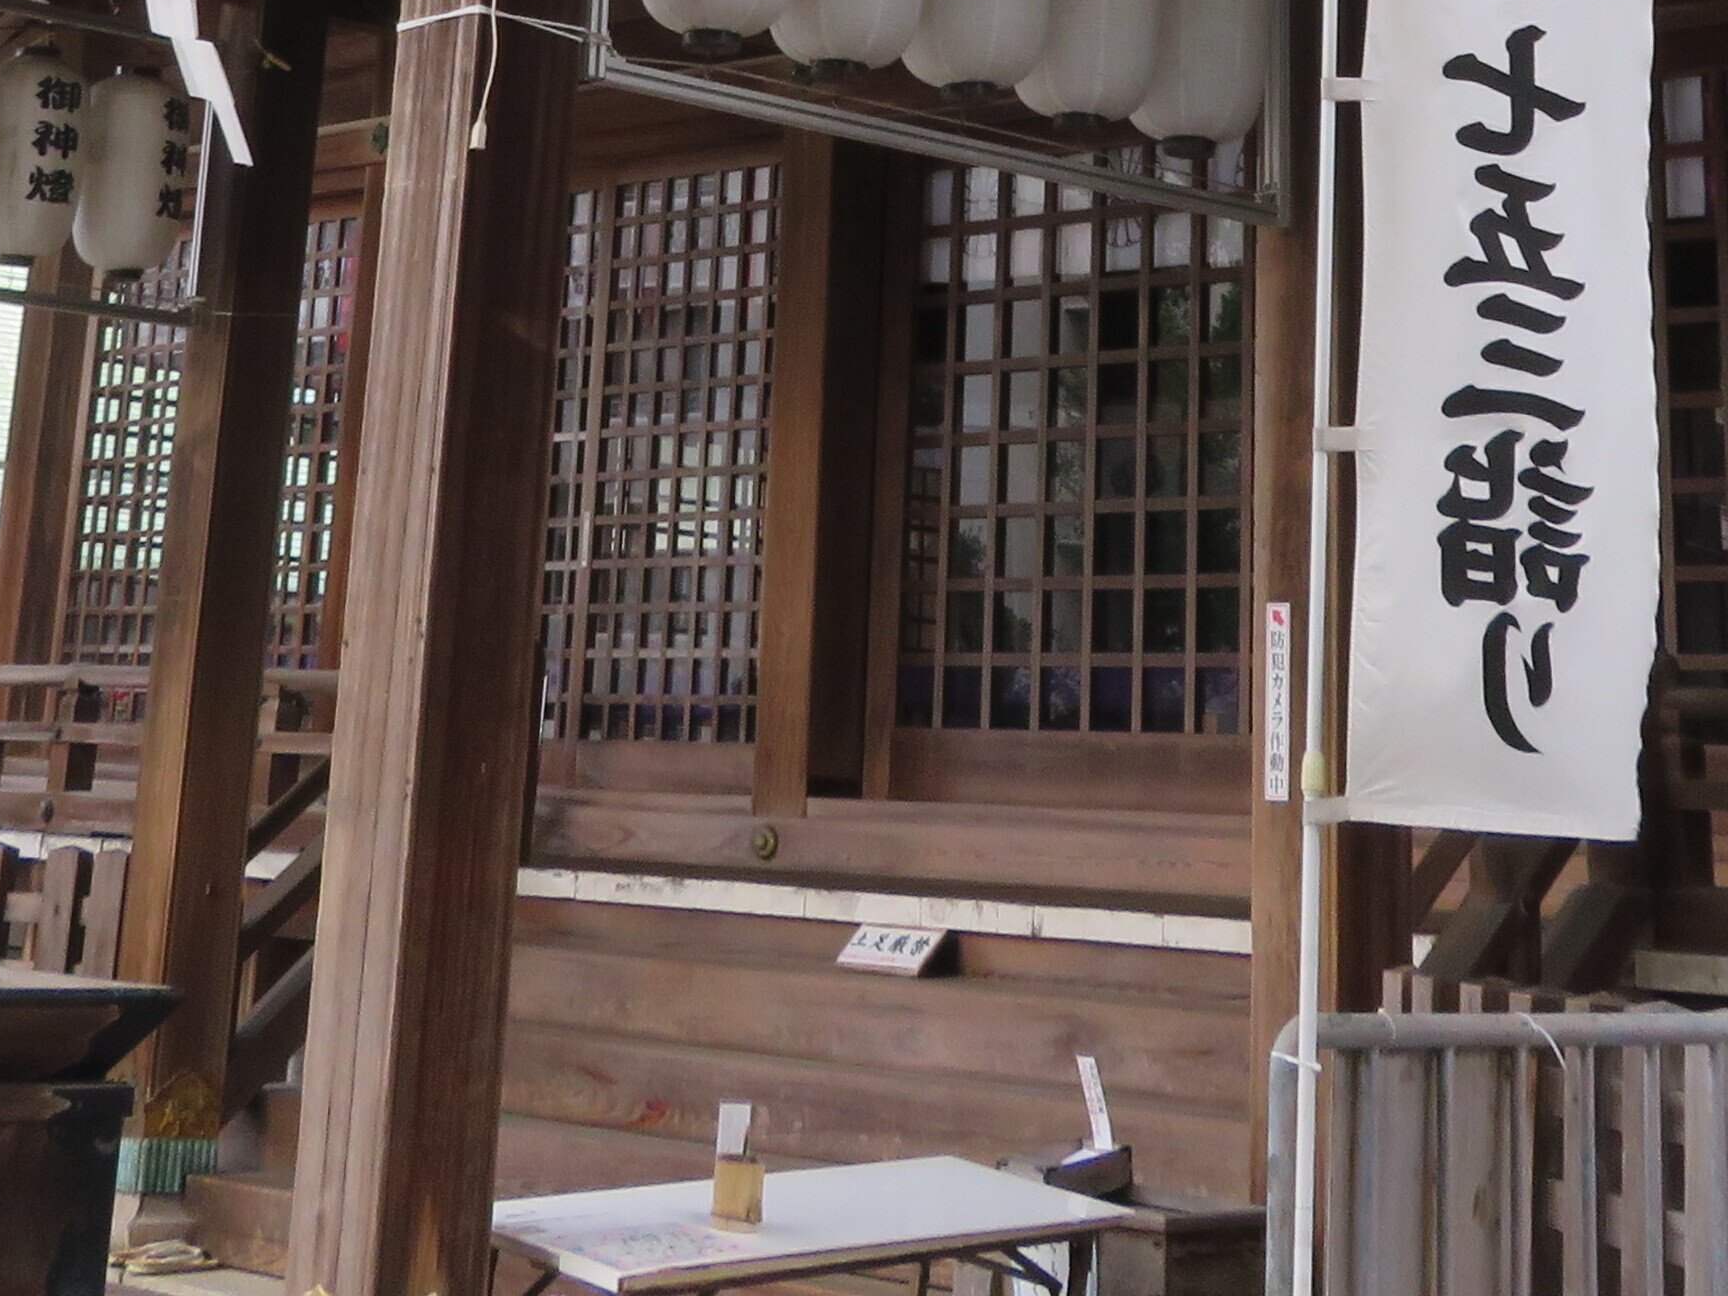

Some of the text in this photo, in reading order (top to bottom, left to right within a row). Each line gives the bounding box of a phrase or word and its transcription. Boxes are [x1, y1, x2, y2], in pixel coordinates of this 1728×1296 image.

[1270, 630, 1286, 795] 防犯カメラ作動中
